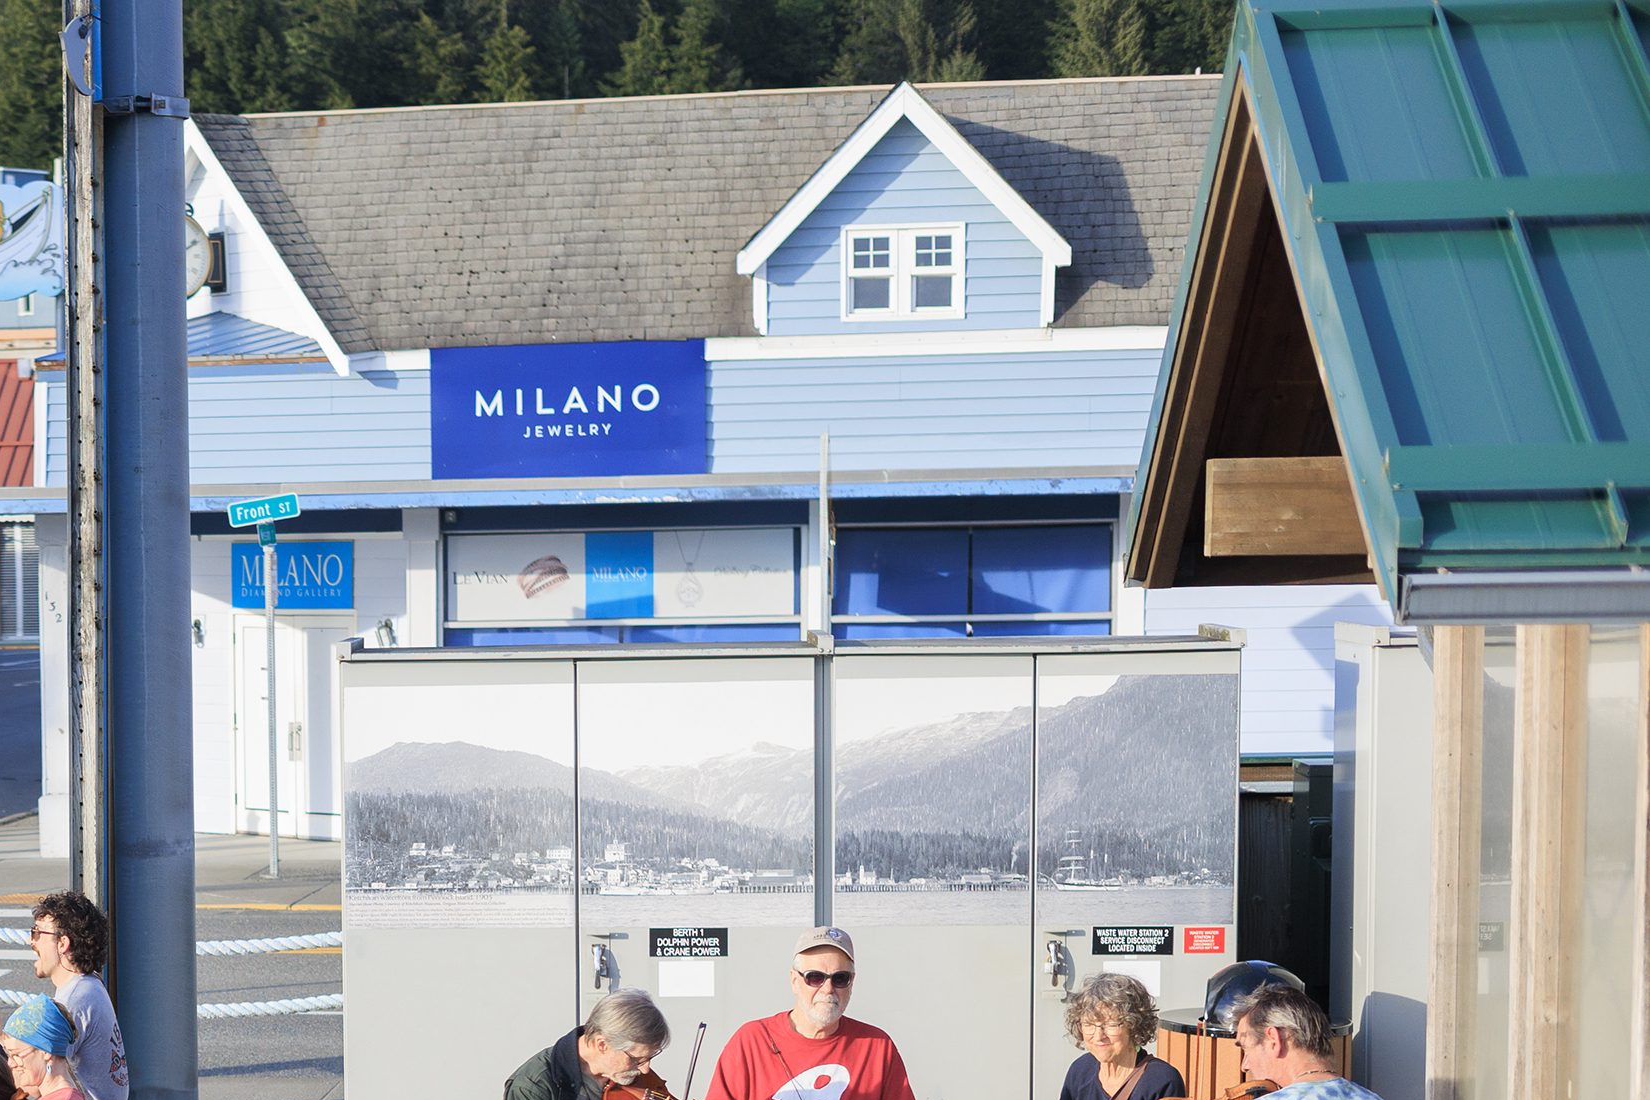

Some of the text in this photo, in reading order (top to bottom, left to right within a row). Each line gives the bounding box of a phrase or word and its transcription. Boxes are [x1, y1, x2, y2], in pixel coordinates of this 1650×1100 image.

[474, 383, 661, 418] MILANO
[522, 422, 613, 439] JEWELRY
[236, 501, 292, 521] Front ST
[241, 553, 344, 587] MIANO
[592, 566, 647, 580] MILANO
[296, 587, 343, 598] GALLERY
[673, 928, 704, 937] BERTH 1
[1096, 929, 1169, 937] WASTE WATER STATION 2
[657, 937, 720, 947] DOLPHIN POWER
[1100, 936, 1166, 945] SERVICE DISCONNECT
[656, 947, 721, 956] & CRANE POWER
[1108, 944, 1157, 952] LOCATED INSIDE
